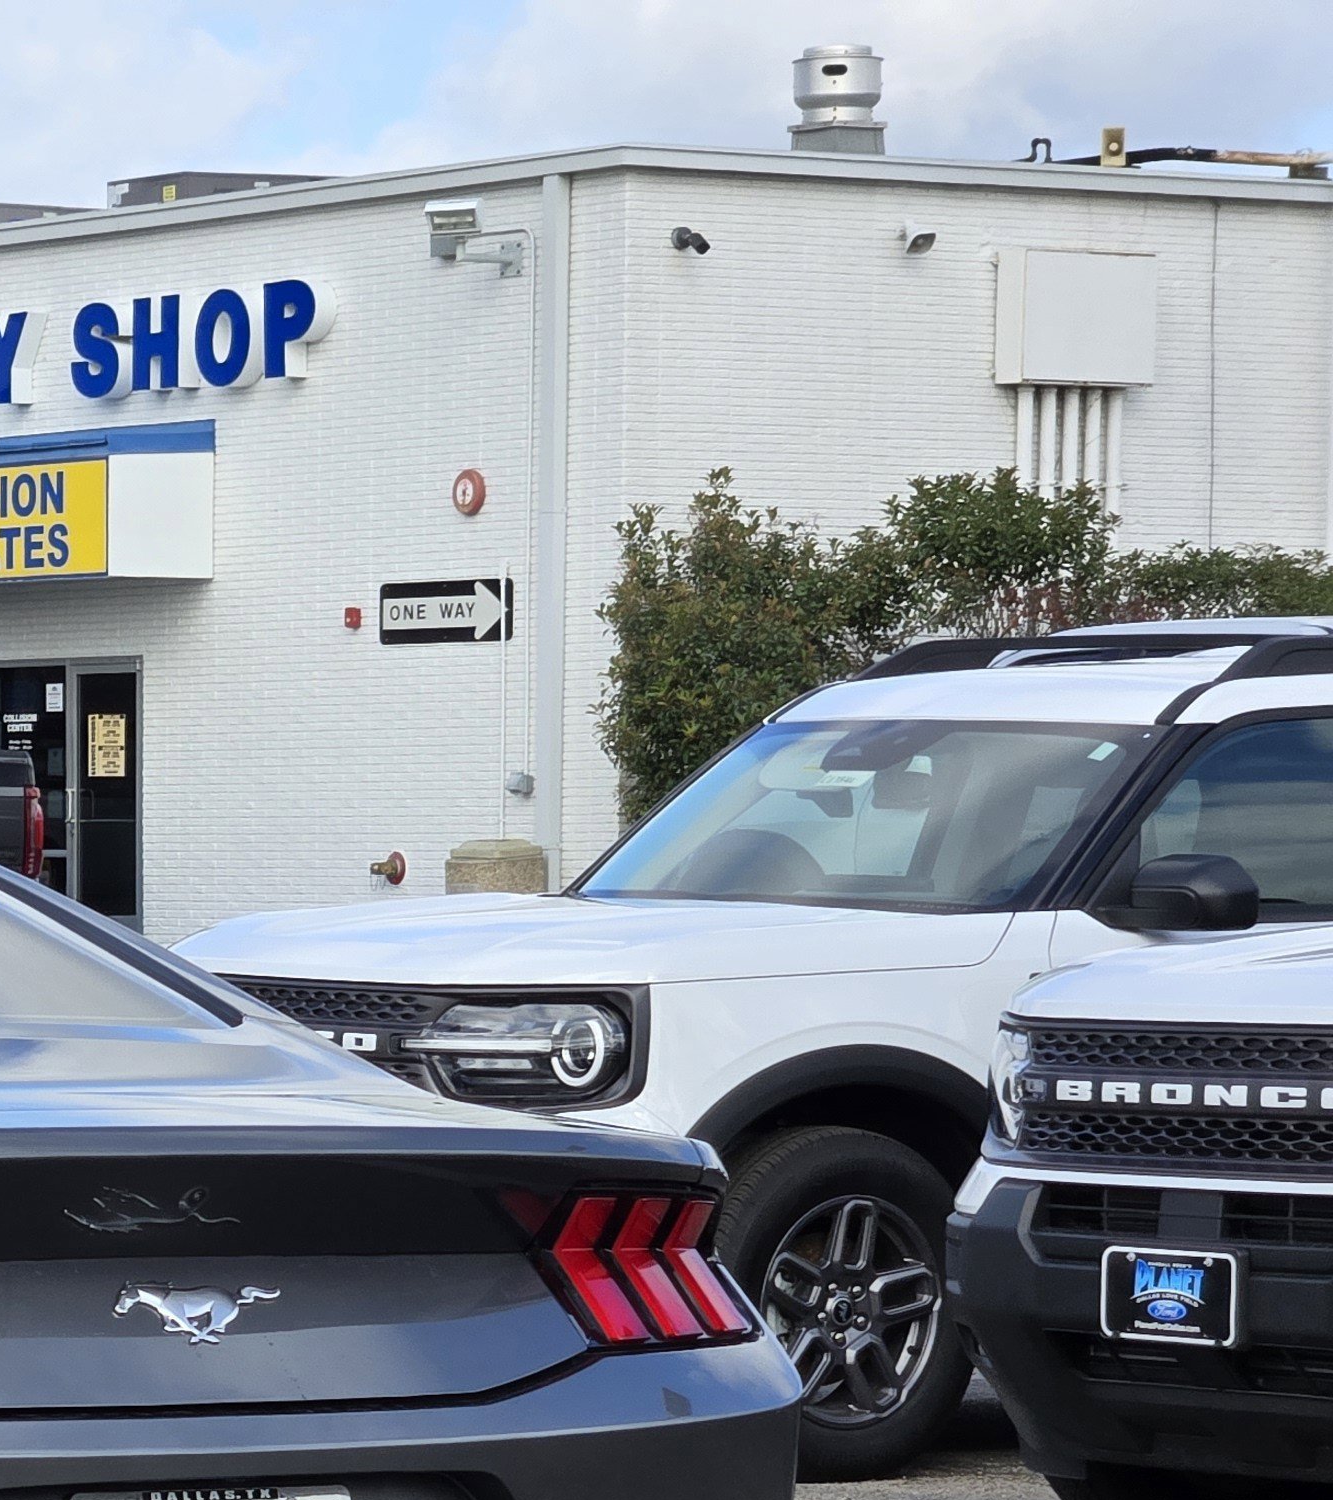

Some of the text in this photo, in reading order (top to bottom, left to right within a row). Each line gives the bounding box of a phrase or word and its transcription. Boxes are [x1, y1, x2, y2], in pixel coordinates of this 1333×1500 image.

[71, 279, 317, 399] SHOP
[388, 598, 477, 623] ONE WAY
[1056, 1080, 1333, 1110] BRONC
[1134, 1258, 1204, 1301] PLANET
